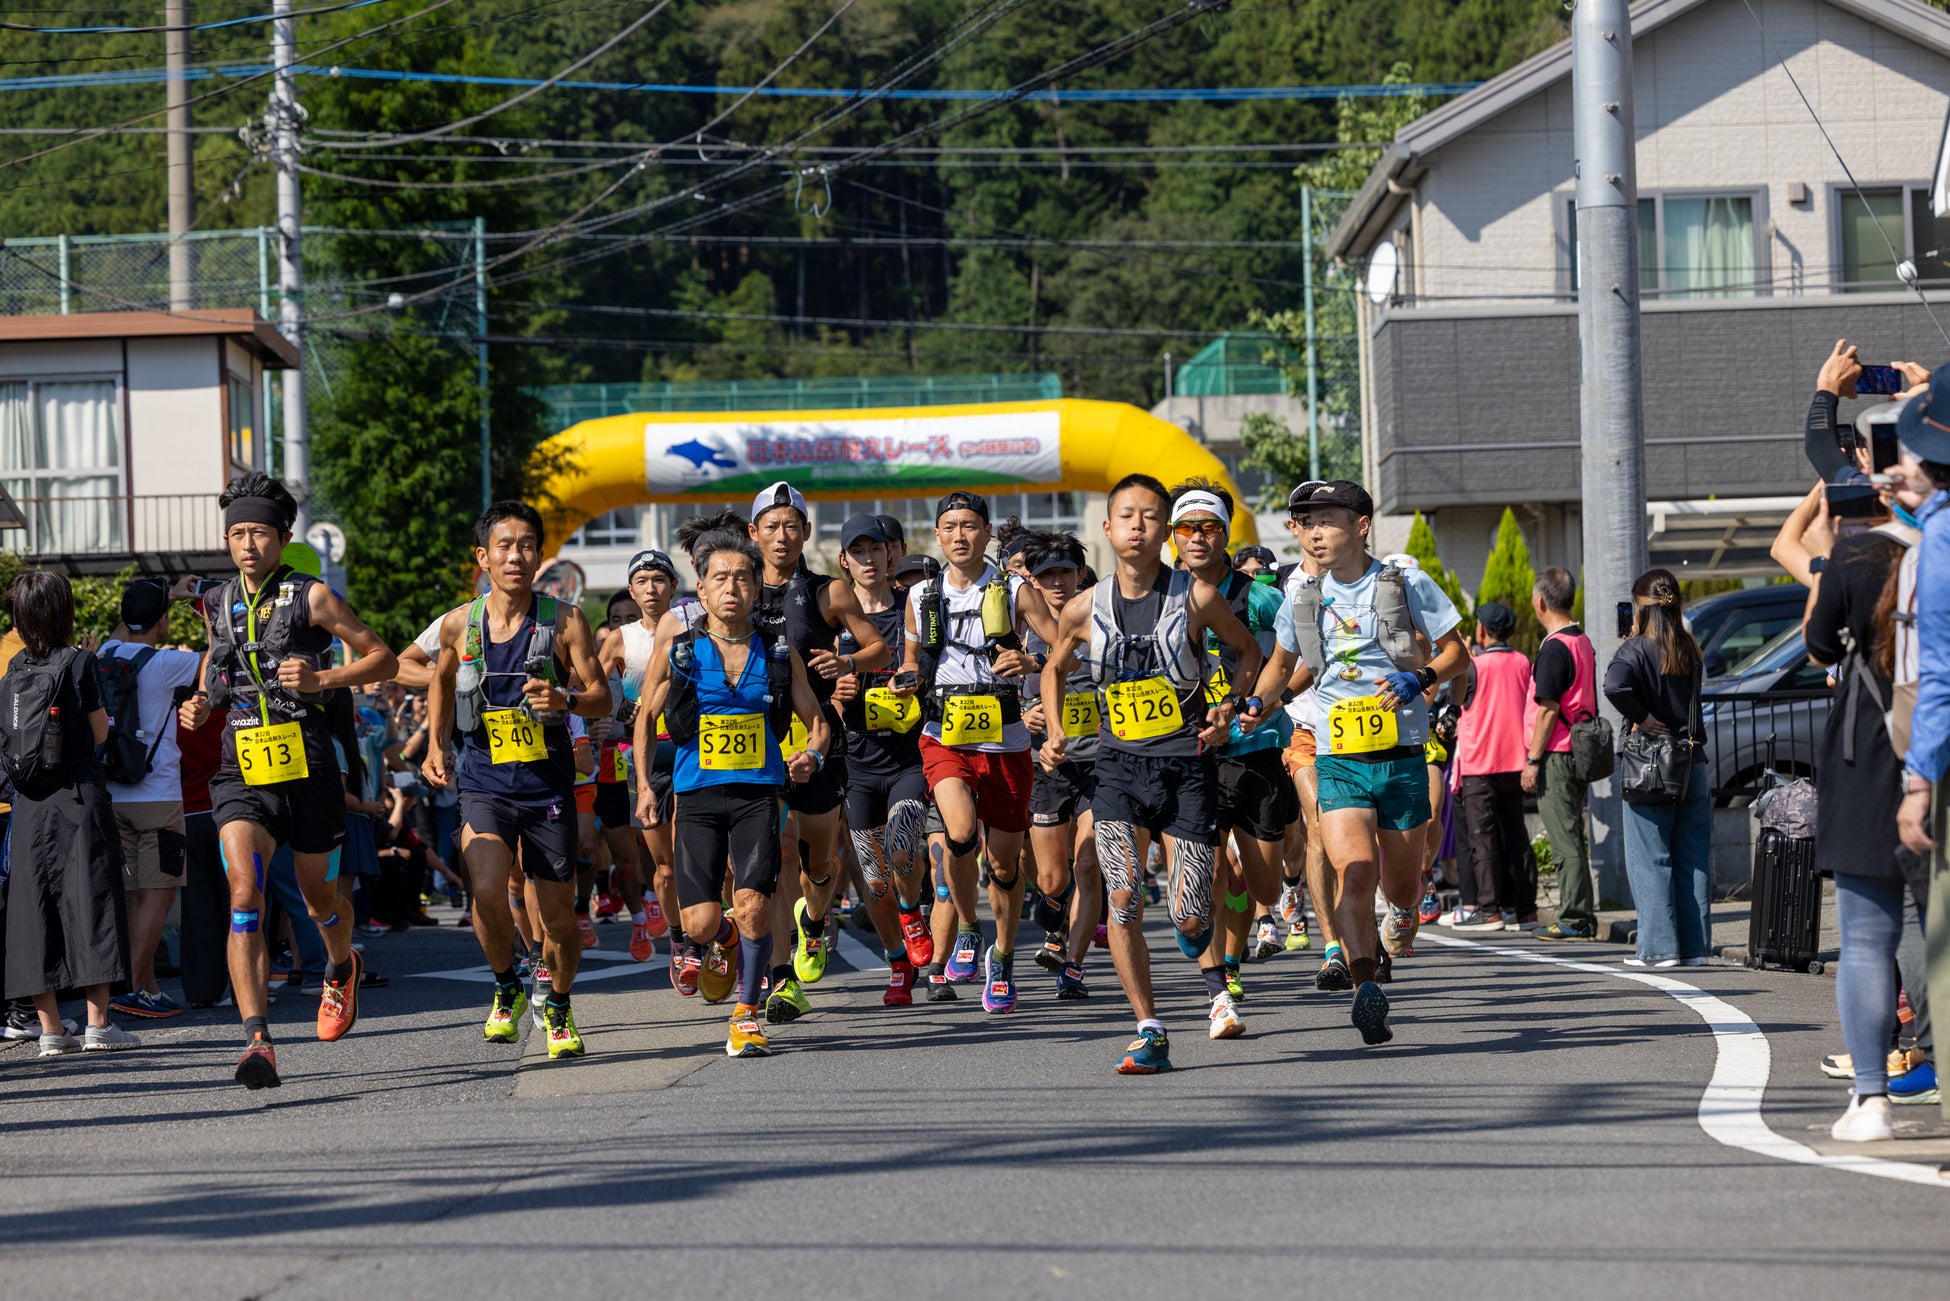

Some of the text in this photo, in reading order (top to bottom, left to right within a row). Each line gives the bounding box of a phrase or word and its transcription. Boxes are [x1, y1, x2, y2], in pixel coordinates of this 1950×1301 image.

[748, 435, 953, 463] 日本山岳耐久レース
[869, 703, 904, 720] S 3
[1070, 707, 1092, 724] 32
[1114, 695, 1174, 724] S126
[945, 712, 990, 731] S 28
[1334, 714, 1383, 738] S 19
[492, 726, 533, 748] S 40
[704, 732, 757, 754] S281
[242, 744, 292, 770] S 13
